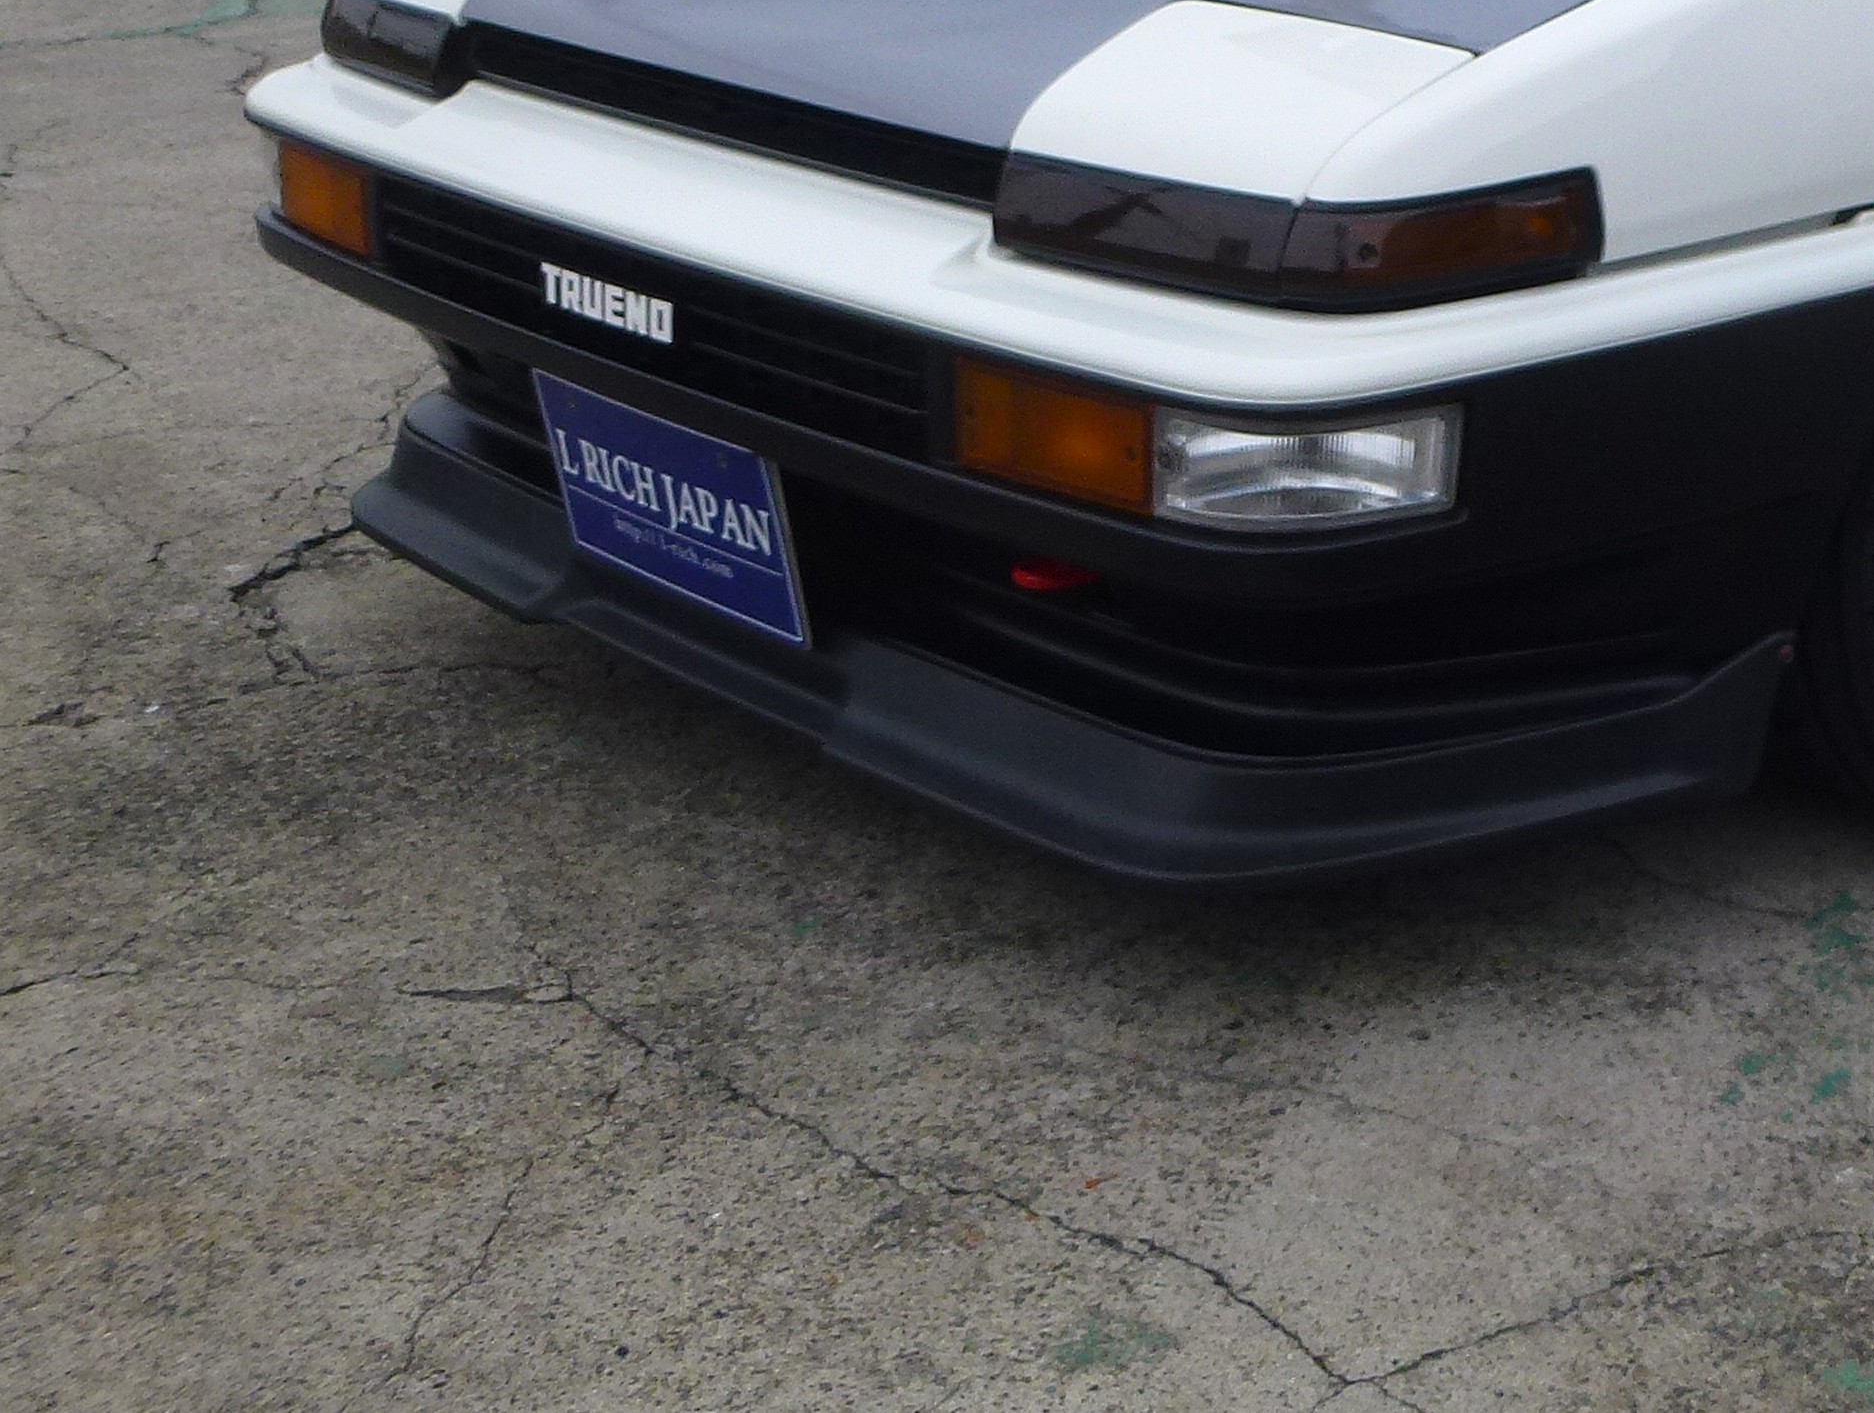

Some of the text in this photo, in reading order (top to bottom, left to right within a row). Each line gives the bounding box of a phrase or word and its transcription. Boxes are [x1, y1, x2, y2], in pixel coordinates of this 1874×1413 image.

[541, 261, 675, 344] TRUENO
[555, 428, 772, 557] L RICH JAPAN
